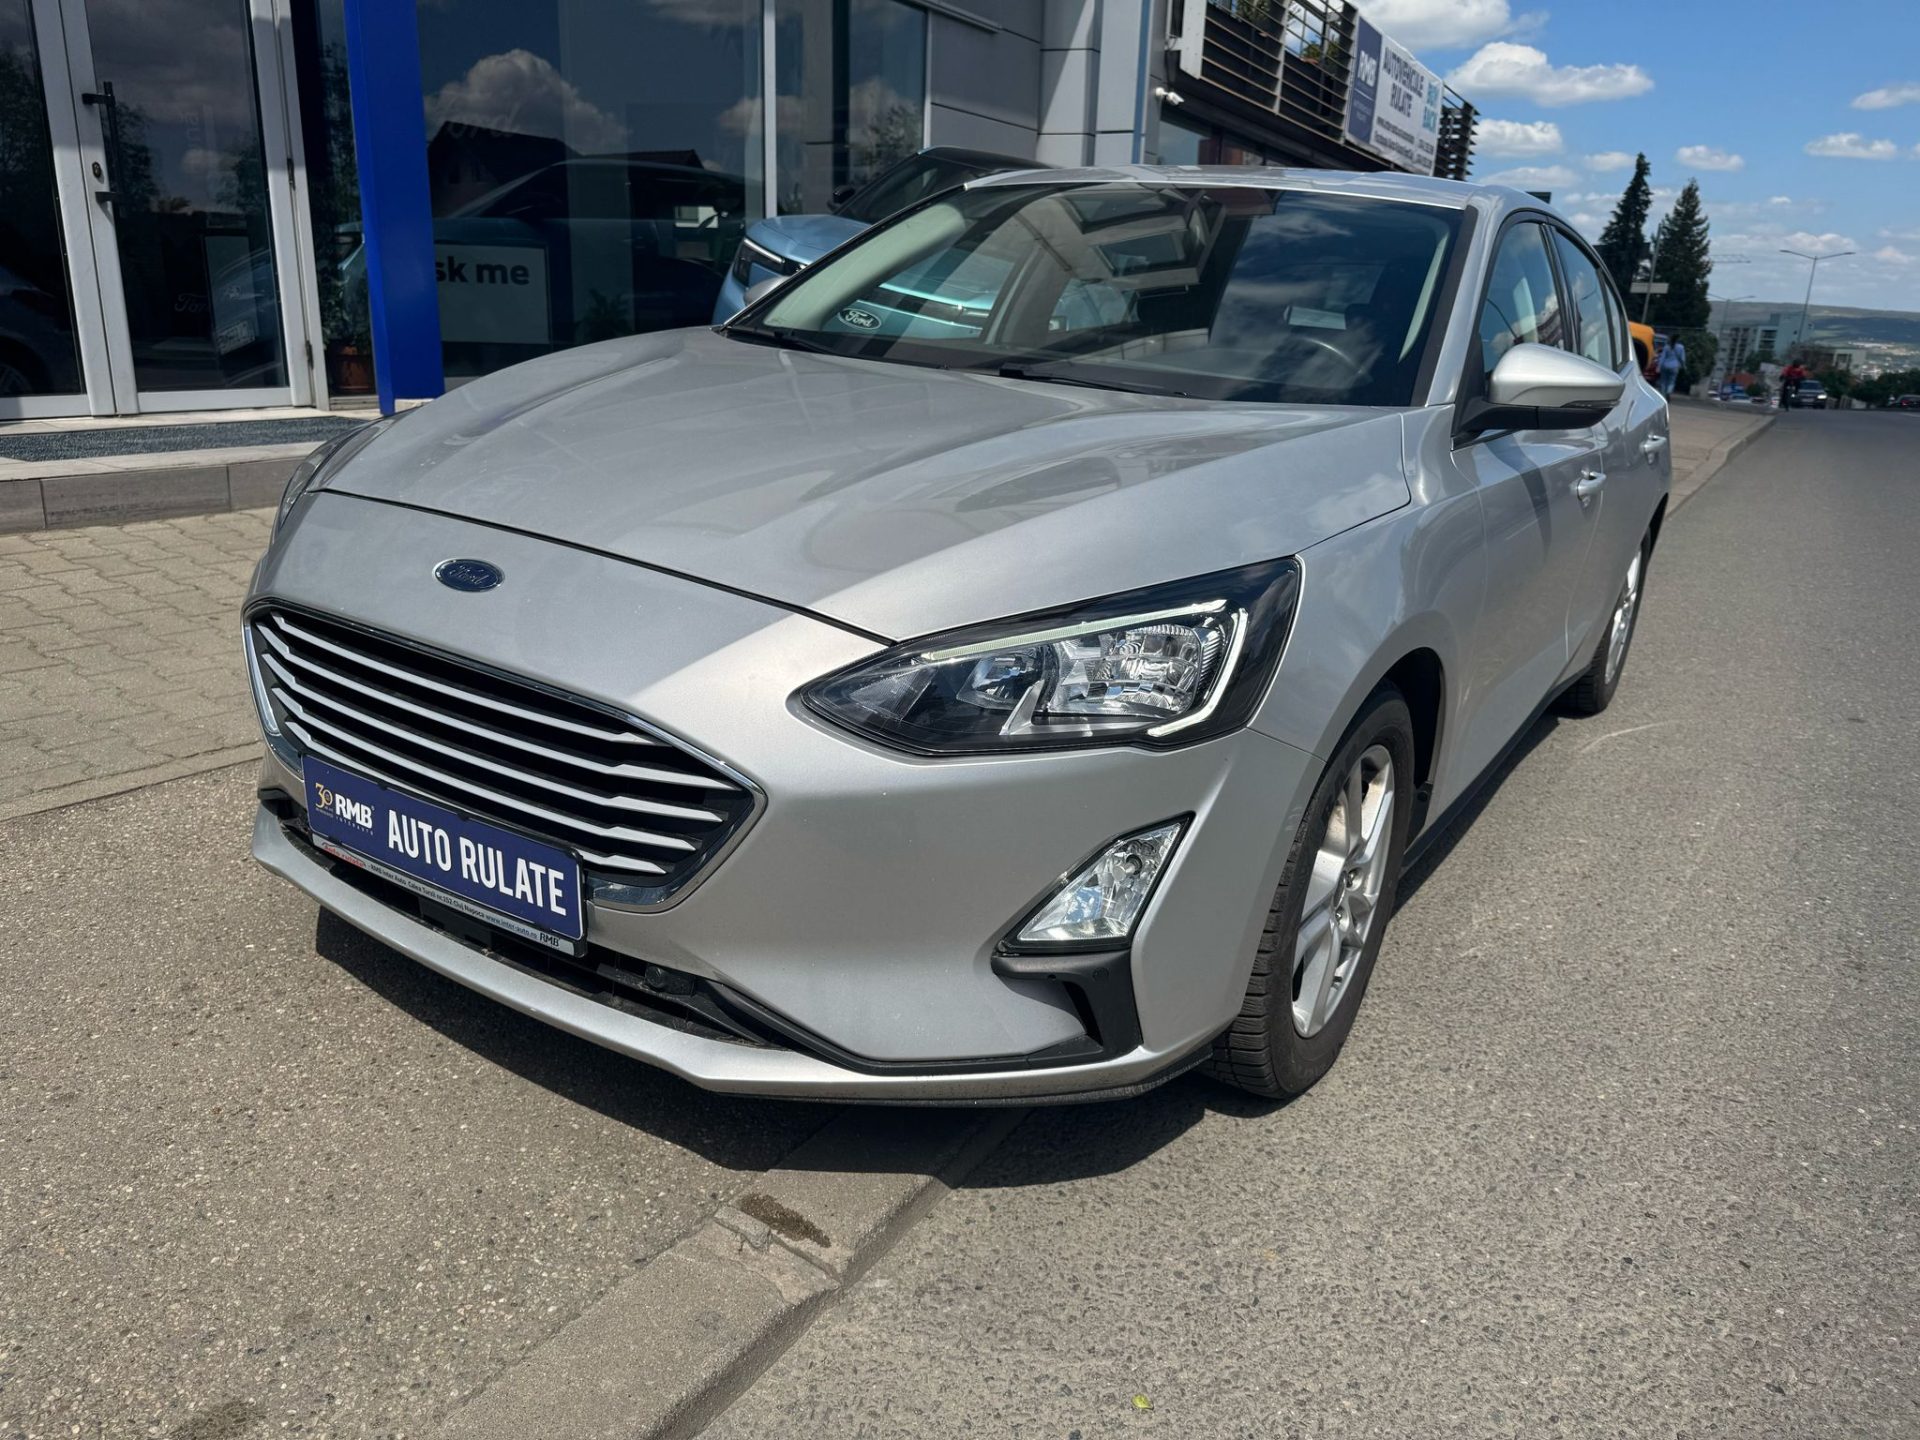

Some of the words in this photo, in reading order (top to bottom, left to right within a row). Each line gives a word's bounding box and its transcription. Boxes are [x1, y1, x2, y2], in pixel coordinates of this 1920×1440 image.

[435, 255, 468, 283] sk
[475, 263, 530, 286] me
[845, 310, 875, 327] Ford
[315, 782, 333, 809] 30
[335, 793, 373, 829] RMB
[388, 809, 452, 872] AUTO
[459, 836, 567, 917] RULATE
[539, 932, 560, 948] RMB
